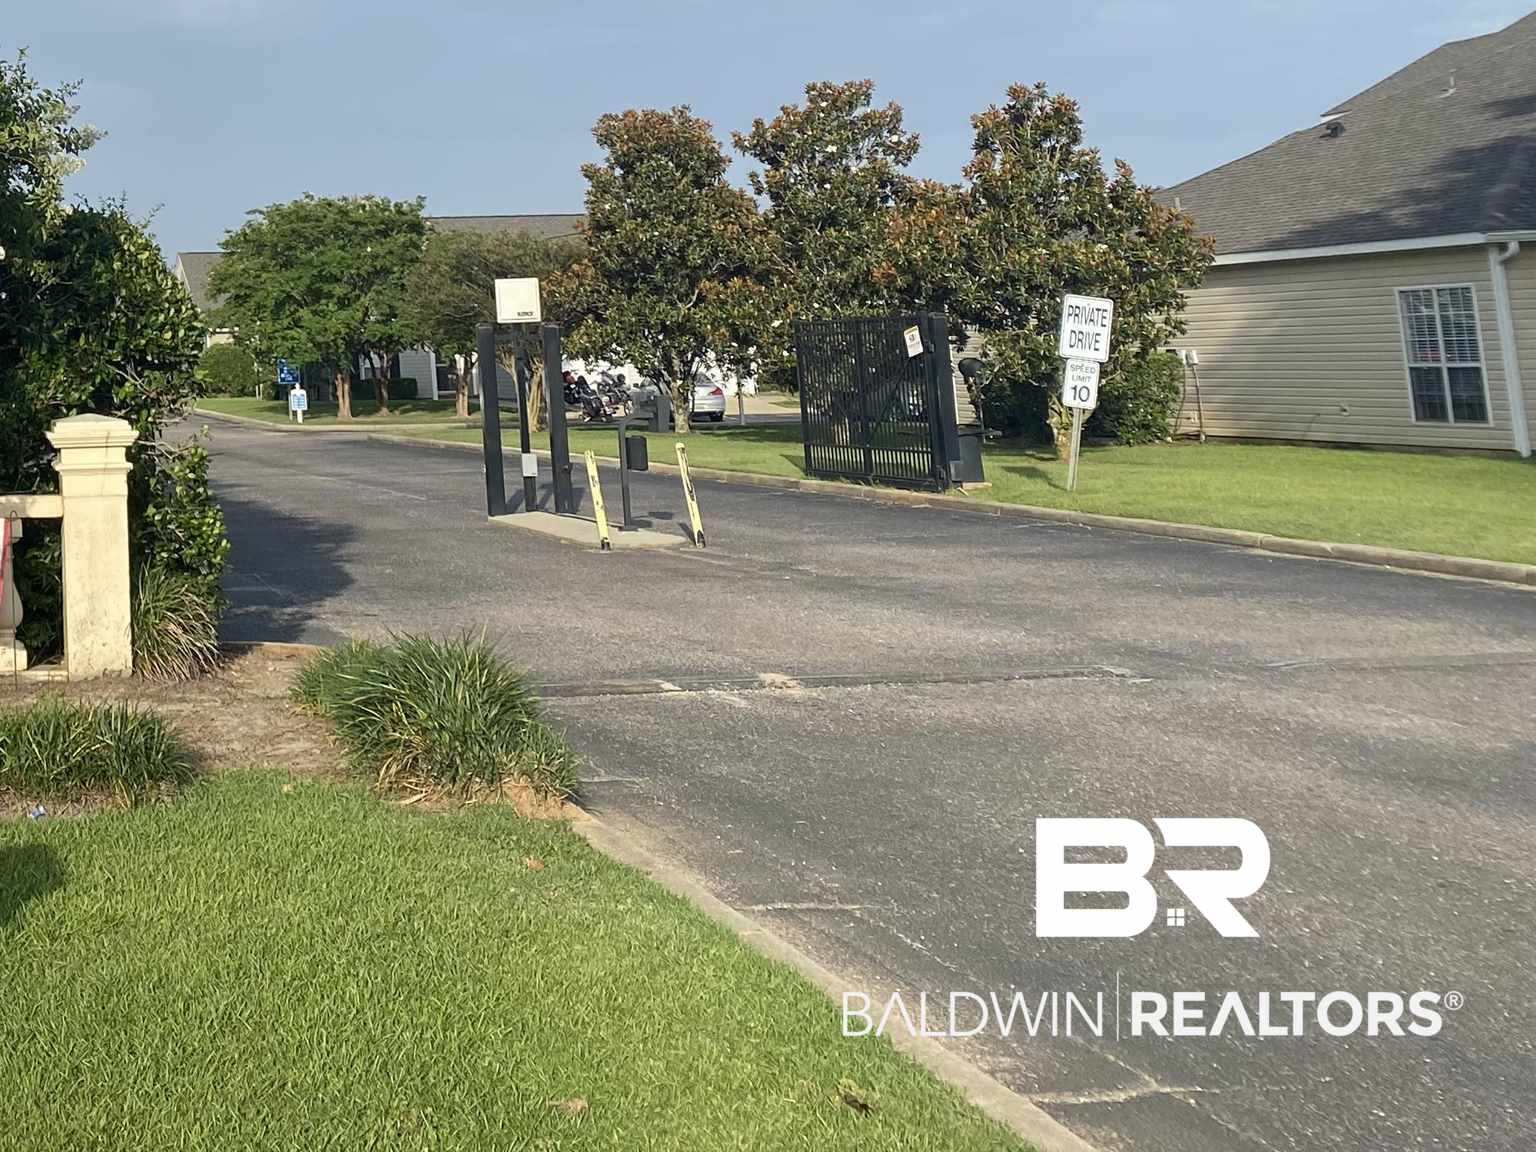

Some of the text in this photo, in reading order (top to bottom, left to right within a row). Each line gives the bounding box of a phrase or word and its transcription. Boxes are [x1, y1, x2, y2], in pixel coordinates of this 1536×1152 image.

[1067, 304, 1108, 328] PRIVATE
[1069, 330, 1101, 352] DRIVE
[1070, 364, 1096, 374] SPEED
[1071, 375, 1092, 383] LIMIT
[1070, 385, 1091, 403] 10
